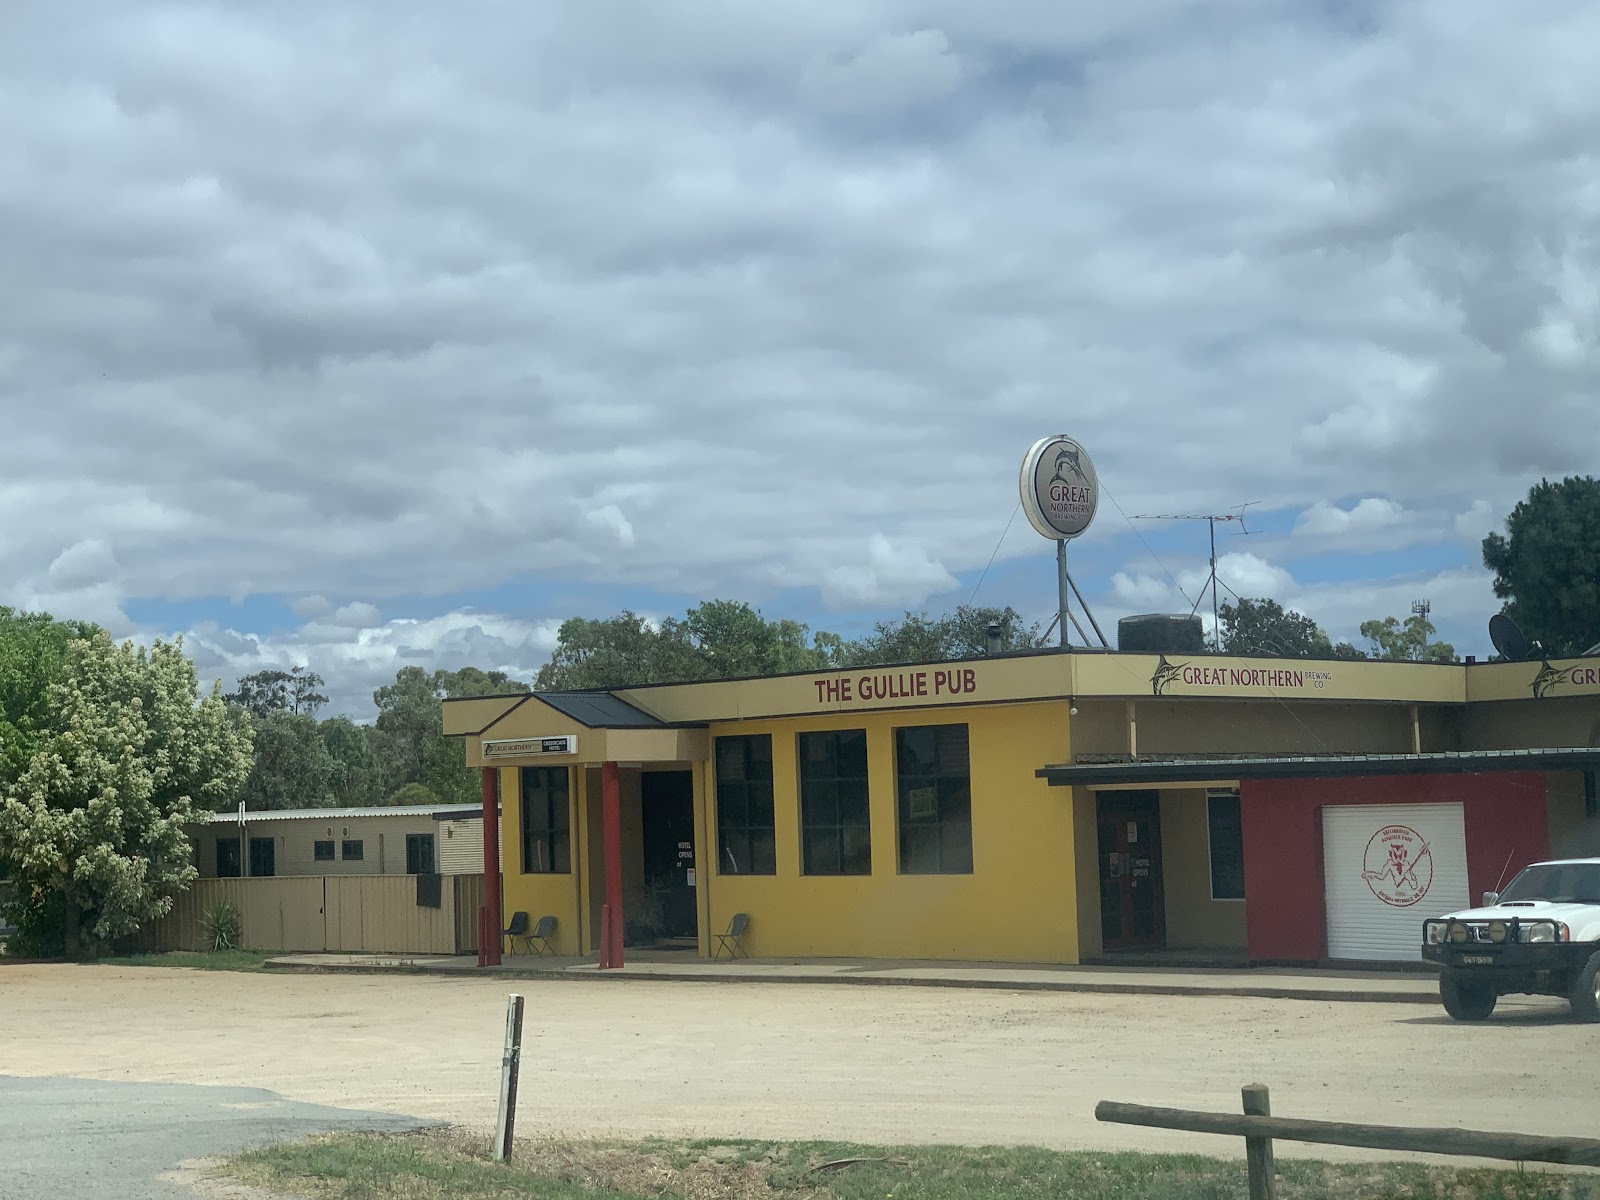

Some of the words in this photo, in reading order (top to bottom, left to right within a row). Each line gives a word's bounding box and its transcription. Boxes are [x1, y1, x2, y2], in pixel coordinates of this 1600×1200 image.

[1049, 485, 1091, 503] GREAT
[1050, 502, 1090, 514] NORTHERN
[1182, 666, 1227, 686] GREAT
[1230, 668, 1304, 688] NORTHERN
[1304, 671, 1332, 680] BREWING
[814, 678, 852, 703] THE
[858, 672, 928, 701] GULLIE
[934, 669, 977, 695] PUB
[1314, 680, 1324, 689] CO
